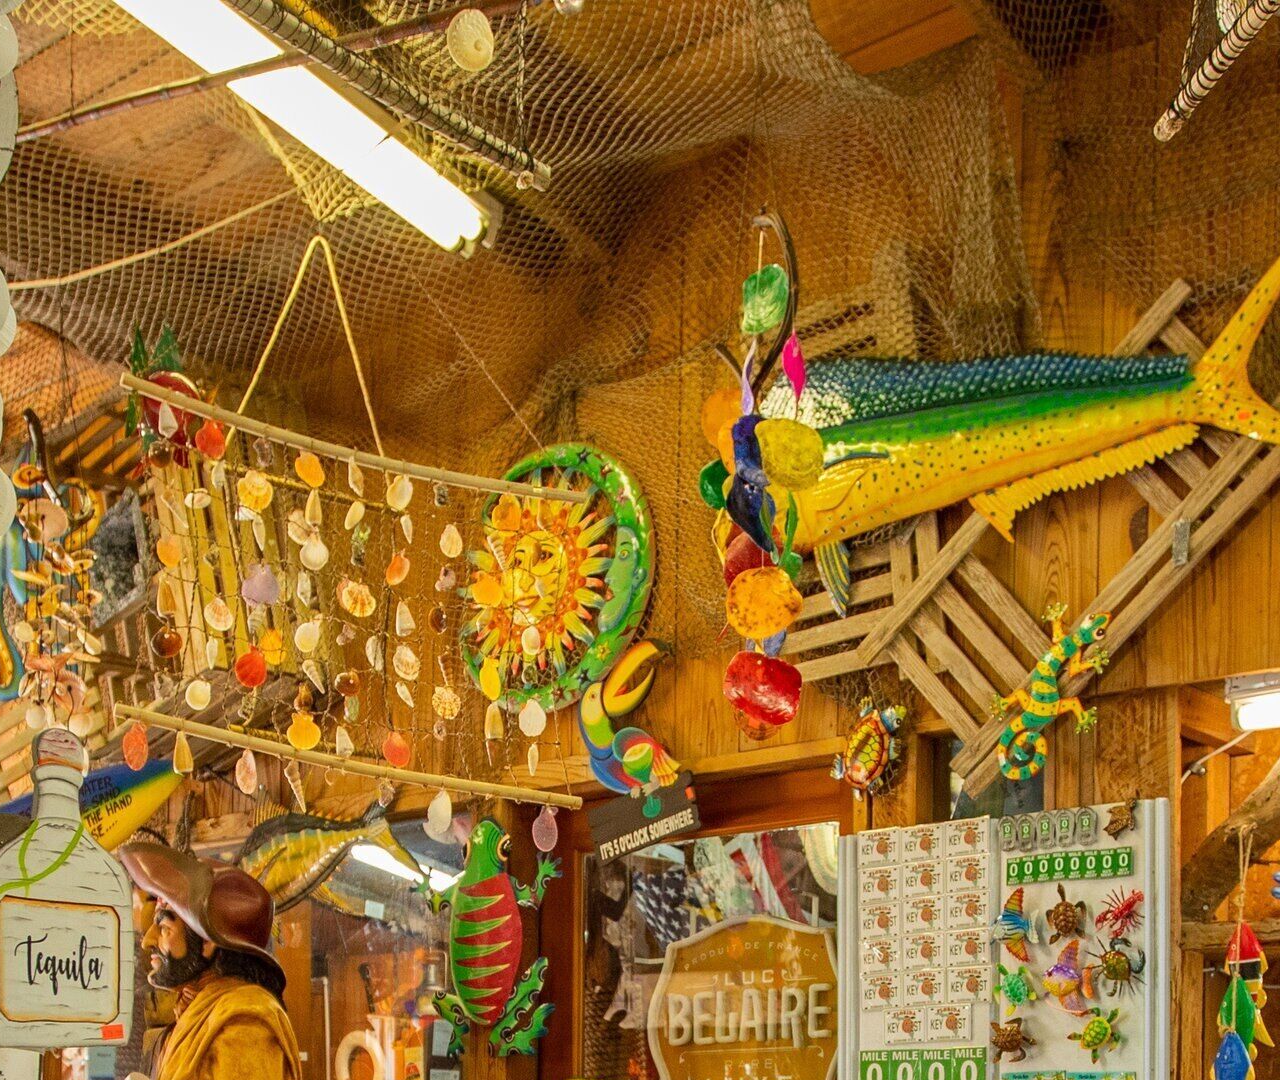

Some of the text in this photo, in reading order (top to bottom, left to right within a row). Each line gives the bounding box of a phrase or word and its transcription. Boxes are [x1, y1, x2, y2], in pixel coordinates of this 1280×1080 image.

[84, 794, 132, 827] THE HAND
[614, 839, 620, 855] 5
[648, 808, 695, 840] SOMEWHERE
[949, 835, 961, 846] KEY
[905, 842, 917, 852] KEY
[1086, 856, 1095, 869] 0
[1103, 855, 1112, 868] 0
[1119, 854, 1128, 866] 0
[1010, 864, 1018, 876] 0
[1024, 862, 1033, 874] 0
[745, 941, 760, 950] DE
[14, 933, 103, 995] Tequila
[724, 969, 775, 986] LUC
[907, 986, 918, 995] KEY
[951, 983, 964, 992] KEY
[668, 983, 833, 1049] BELAIRE
[888, 1023, 899, 1033] KEY
[931, 1020, 943, 1030] KEY
[862, 1053, 888, 1061] MILE
[892, 1052, 918, 1060] MILE
[924, 1051, 950, 1060] MILE
[955, 1049, 983, 1058] MILE
